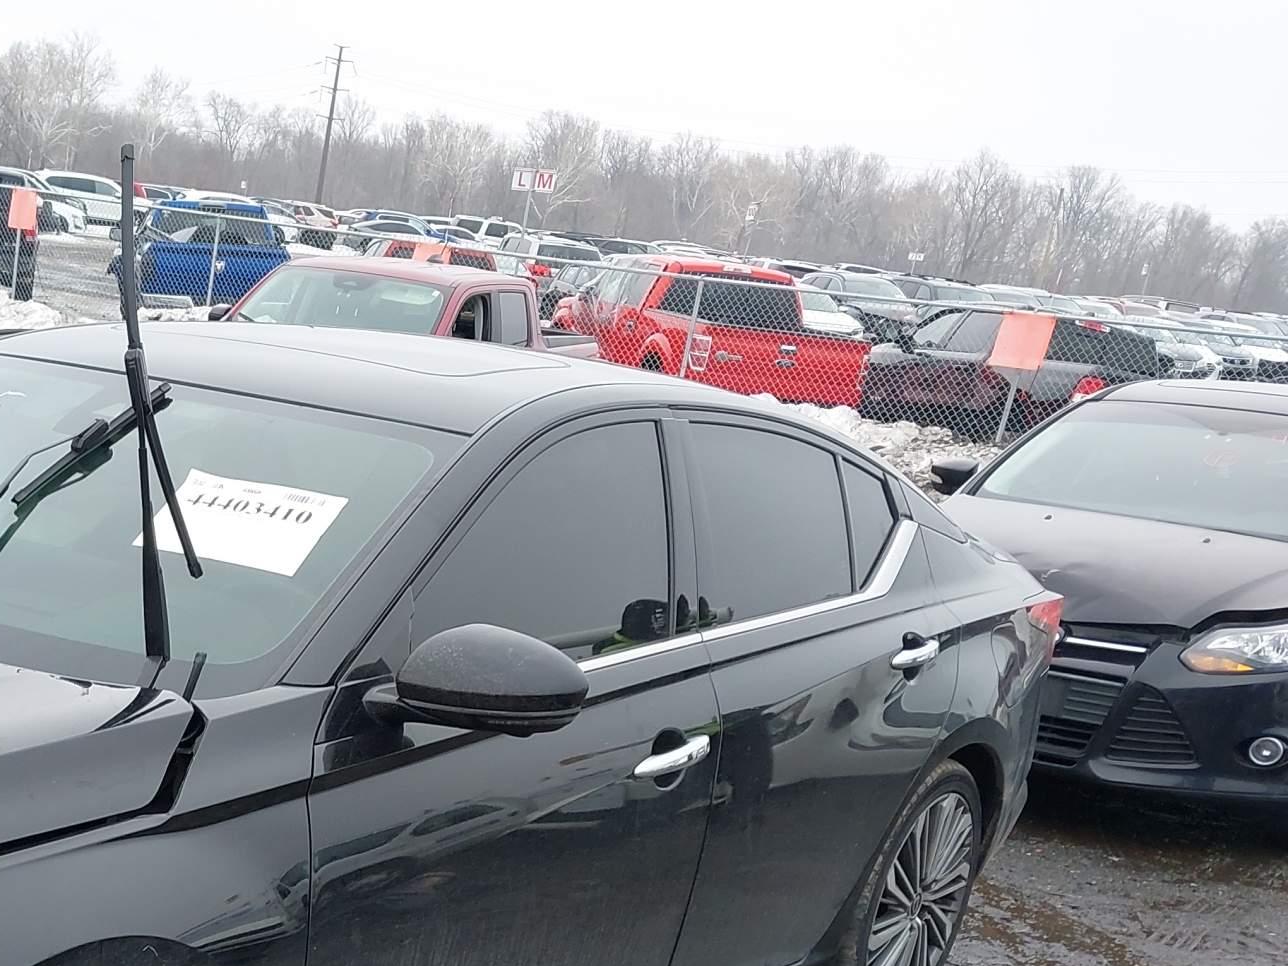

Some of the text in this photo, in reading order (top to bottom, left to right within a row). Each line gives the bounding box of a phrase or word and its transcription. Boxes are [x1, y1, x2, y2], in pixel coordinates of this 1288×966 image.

[518, 171, 554, 189] L M
[186, 493, 313, 524] 44403410
